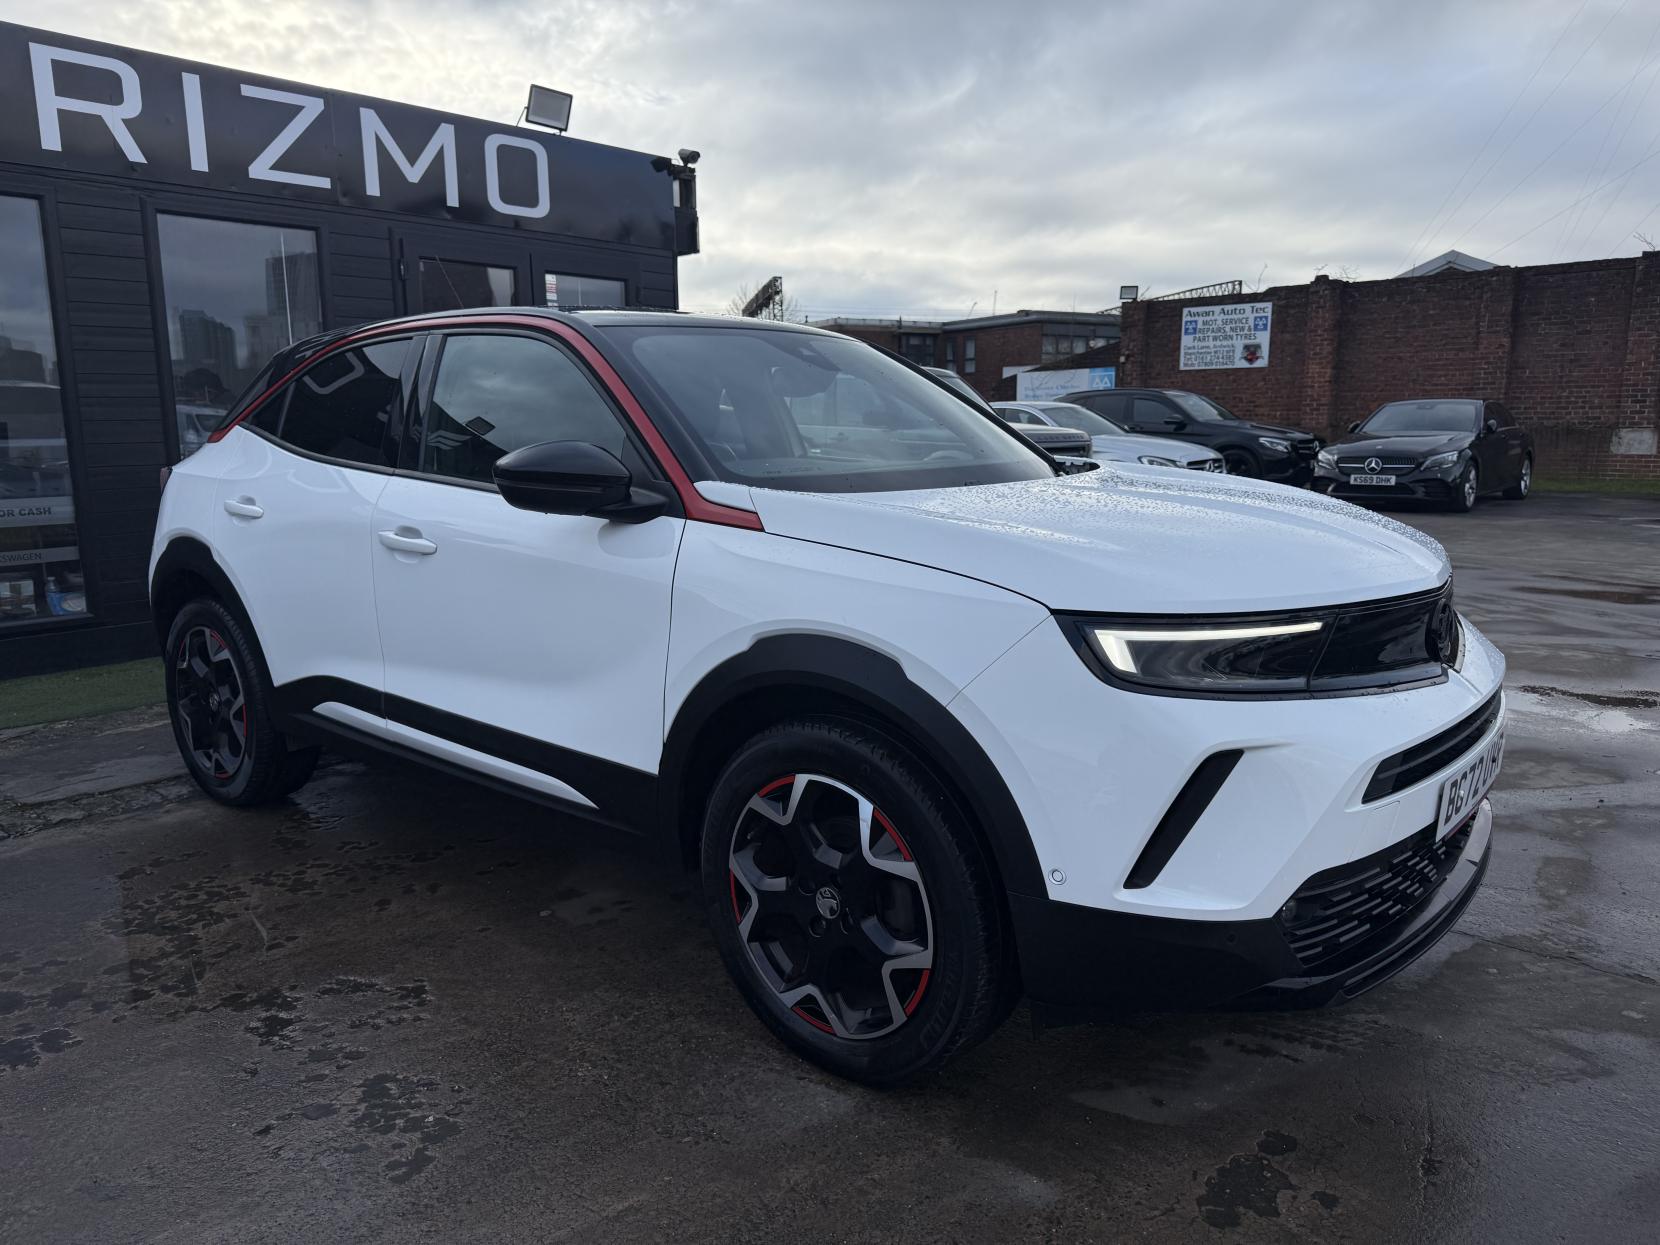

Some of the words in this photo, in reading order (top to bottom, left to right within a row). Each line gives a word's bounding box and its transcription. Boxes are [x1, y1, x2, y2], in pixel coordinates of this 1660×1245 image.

[28, 42, 551, 219] RIZMO
[1185, 310, 1215, 318] Awan
[1219, 307, 1246, 316] Auto
[1250, 306, 1269, 314] Tec
[1221, 317, 1249, 326] SERVICE
[1229, 325, 1246, 333] NEW
[1192, 335, 1211, 343] PART
[1212, 334, 1234, 342] WORN
[1235, 332, 1257, 341] TYRES
[18, 506, 52, 517] CASH
